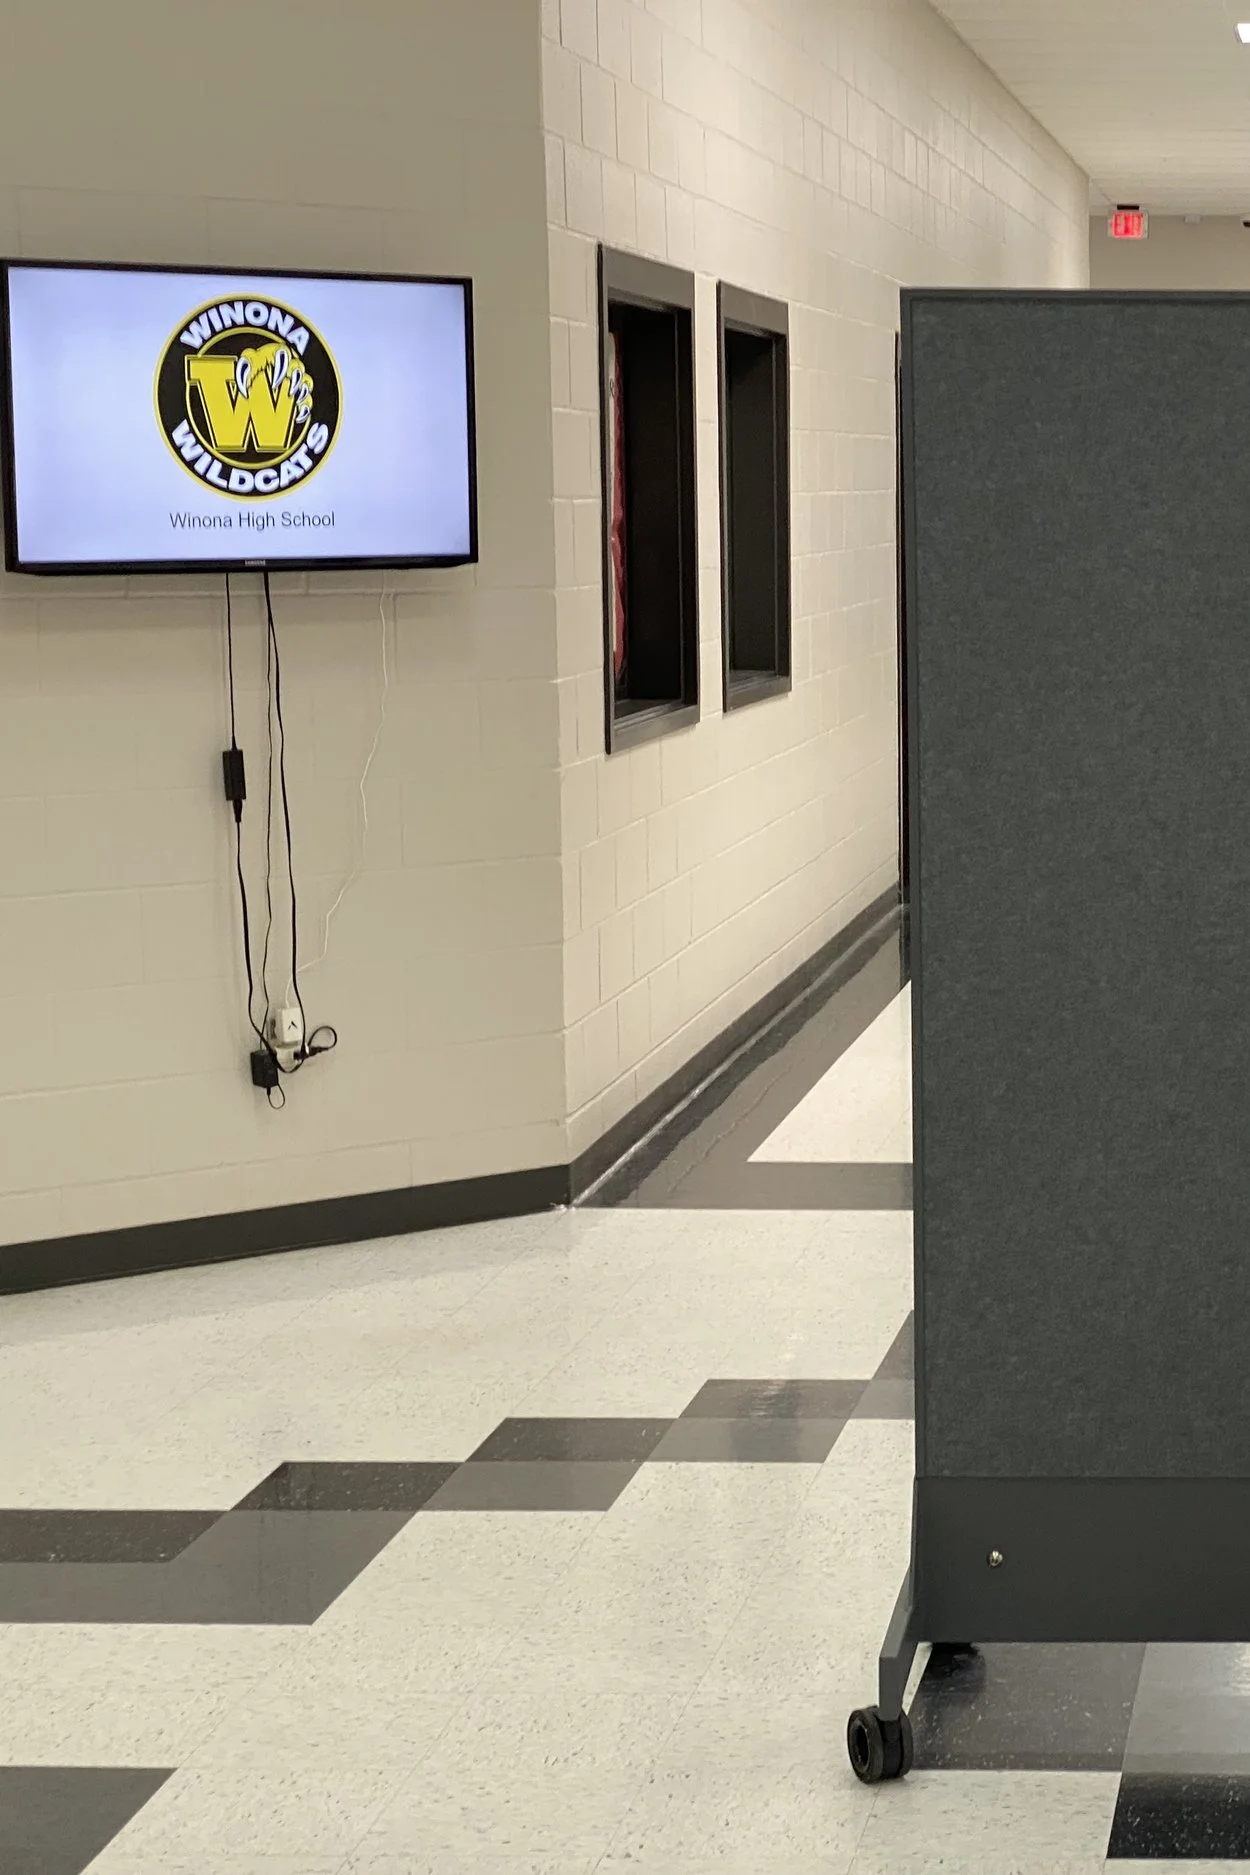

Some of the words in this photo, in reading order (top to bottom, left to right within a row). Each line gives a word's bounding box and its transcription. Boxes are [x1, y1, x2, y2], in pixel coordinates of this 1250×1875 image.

[1113, 212, 1143, 237] EXIT
[180, 302, 310, 355] WINONA
[172, 419, 329, 493] WILDCATS
[169, 512, 233, 529] Winona
[238, 511, 275, 532] High
[281, 511, 335, 528] School
